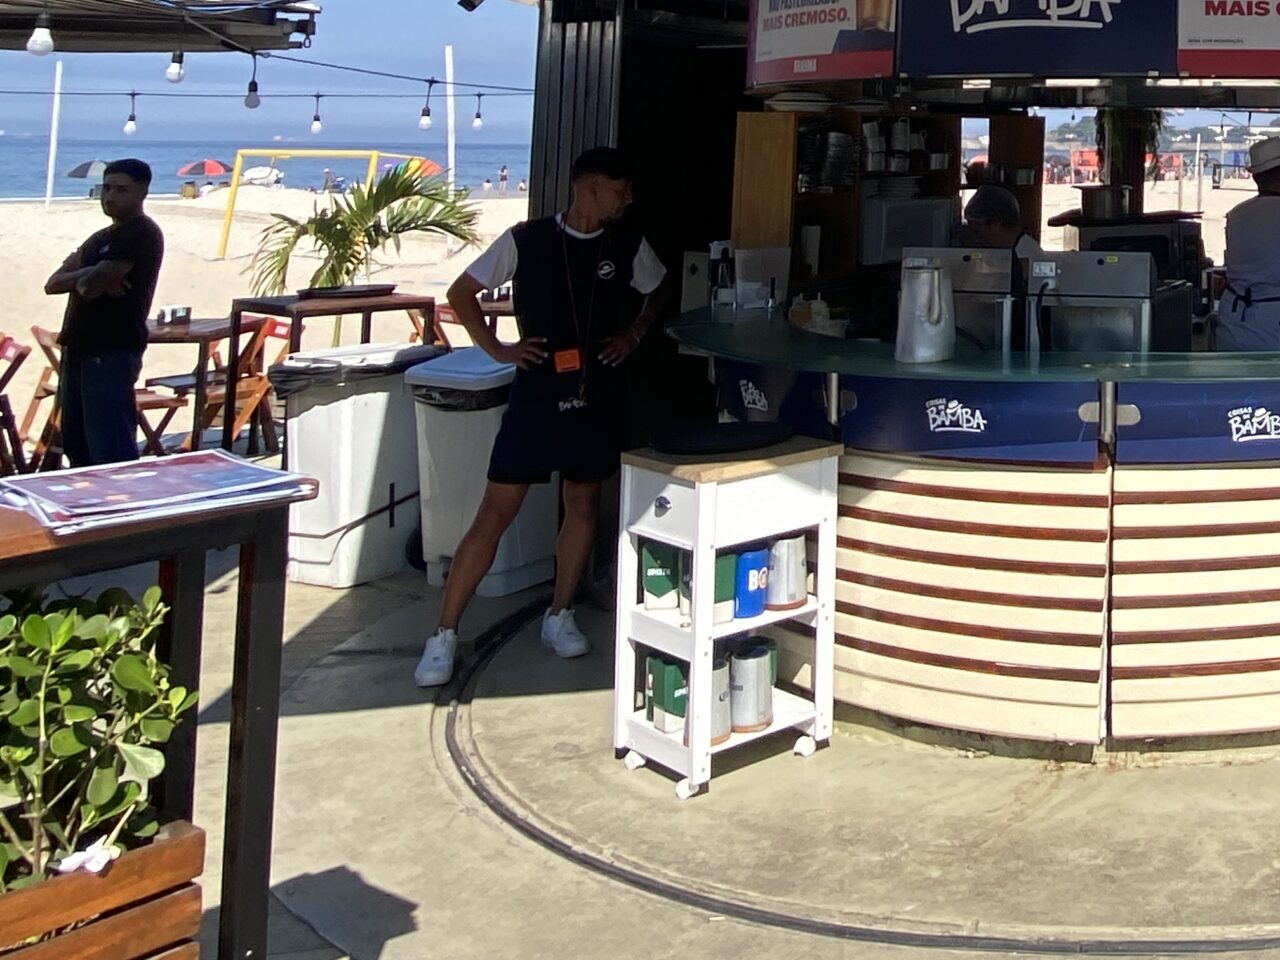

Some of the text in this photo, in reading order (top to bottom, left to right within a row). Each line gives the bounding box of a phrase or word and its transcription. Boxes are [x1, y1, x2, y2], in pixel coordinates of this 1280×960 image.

[784, 7, 851, 29] CREMOSO.
[1204, 0, 1270, 16] MAIS
[926, 404, 988, 431] BAMBA
